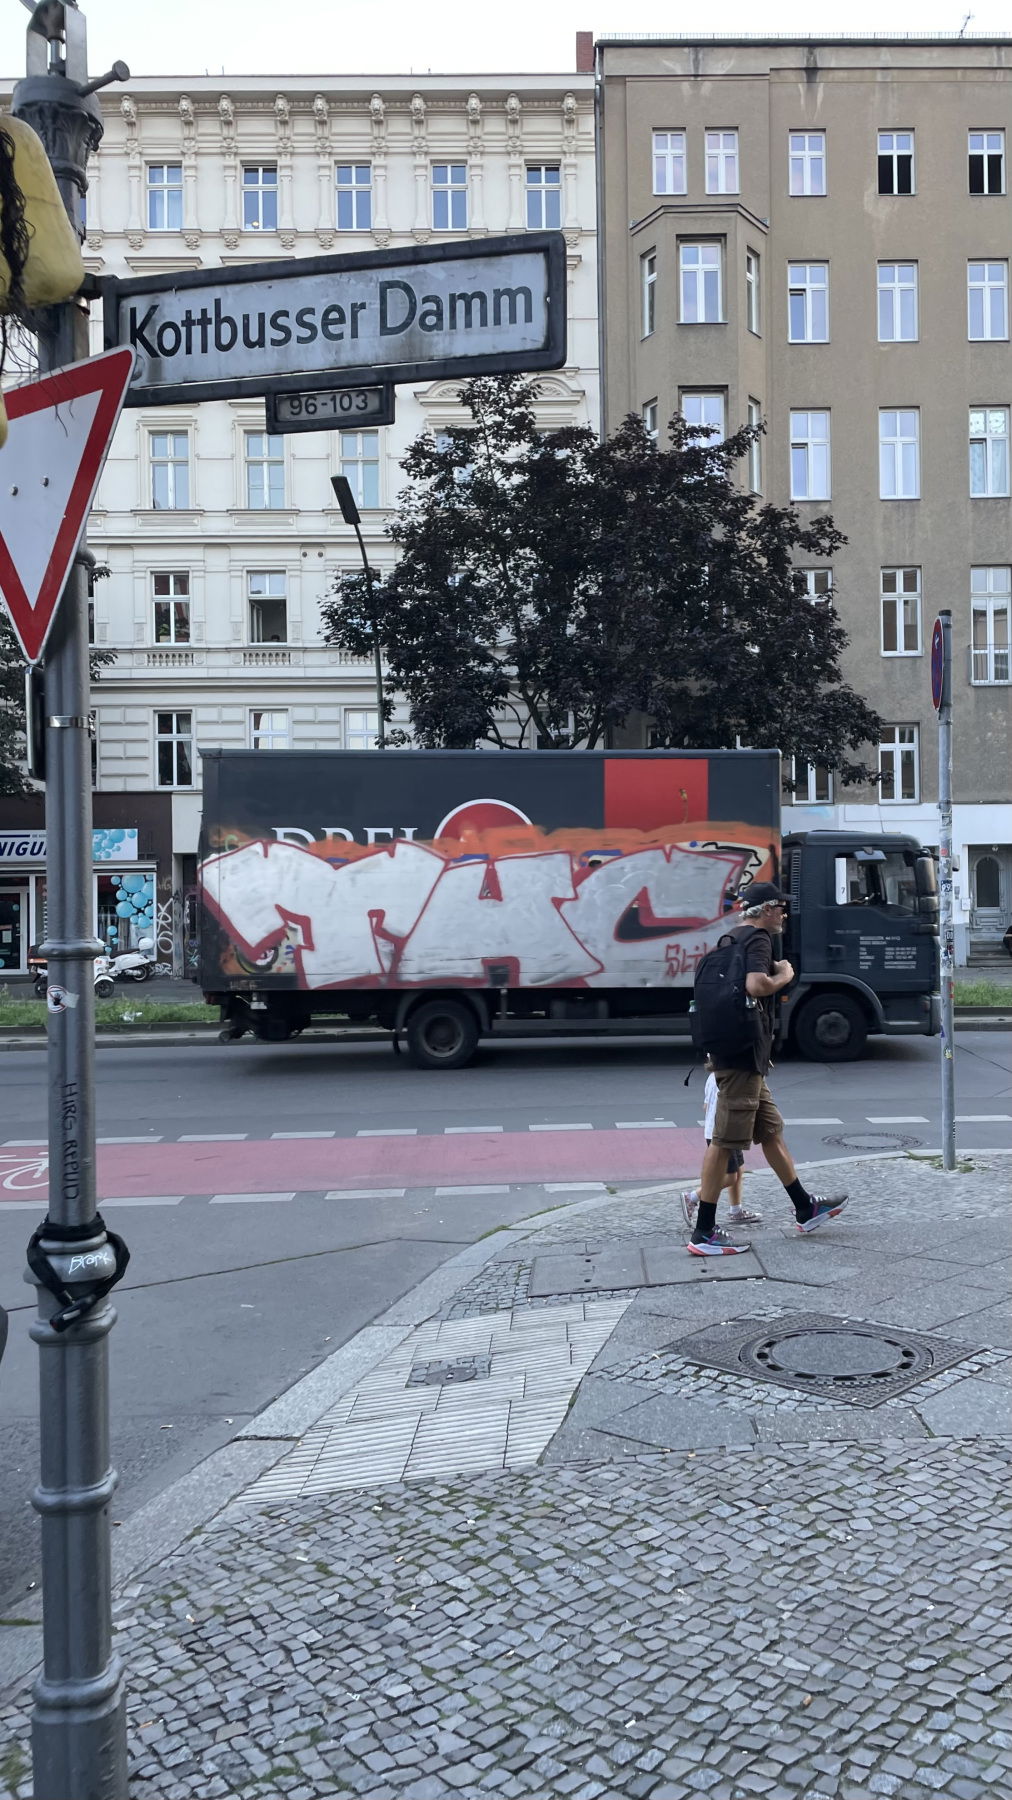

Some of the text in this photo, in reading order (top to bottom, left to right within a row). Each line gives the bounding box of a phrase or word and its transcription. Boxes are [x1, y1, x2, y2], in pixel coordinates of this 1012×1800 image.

[129, 279, 533, 359] Kottbusser Damm
[289, 391, 368, 417] 96-103
